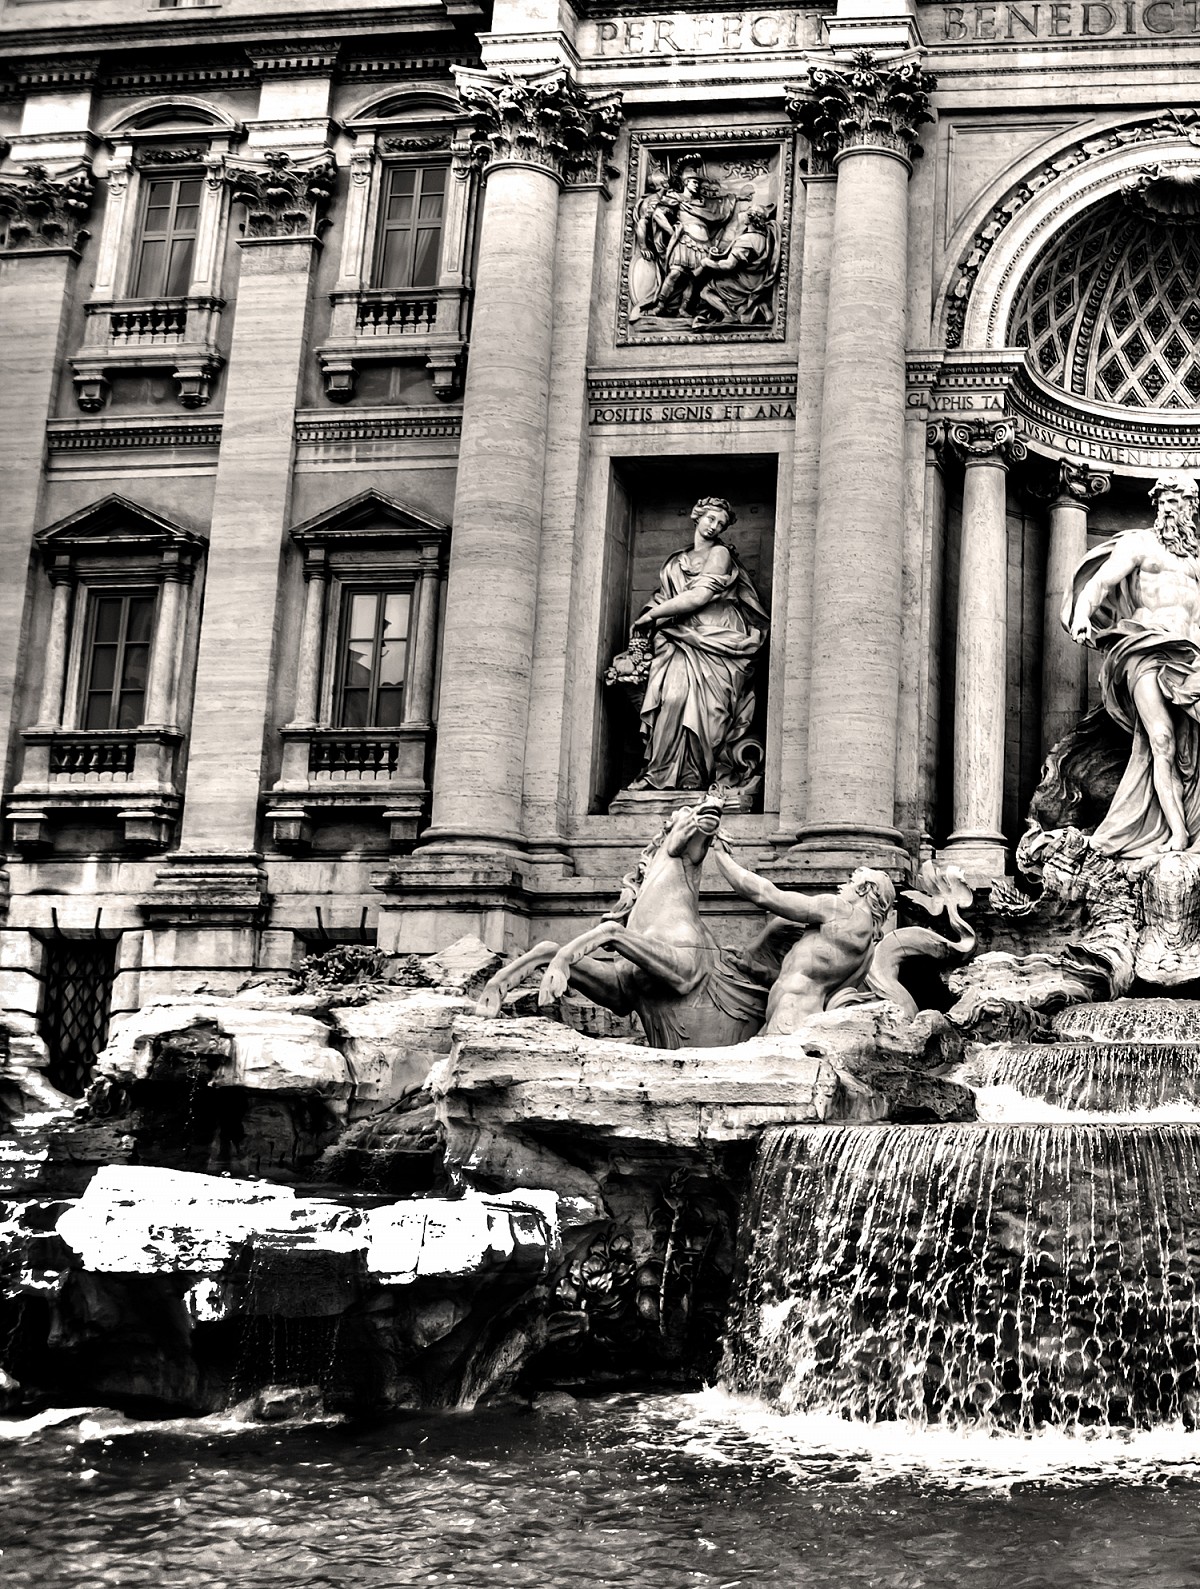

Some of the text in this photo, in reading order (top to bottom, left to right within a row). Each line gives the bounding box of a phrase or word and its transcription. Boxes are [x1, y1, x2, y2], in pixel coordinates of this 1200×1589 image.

[592, 13, 833, 55] PERFECIT
[593, 403, 796, 423] POSITIS SIGNIS ET ANA
[1023, 418, 1056, 445] IVSSV
[1065, 437, 1172, 467] CLEMENTIS
